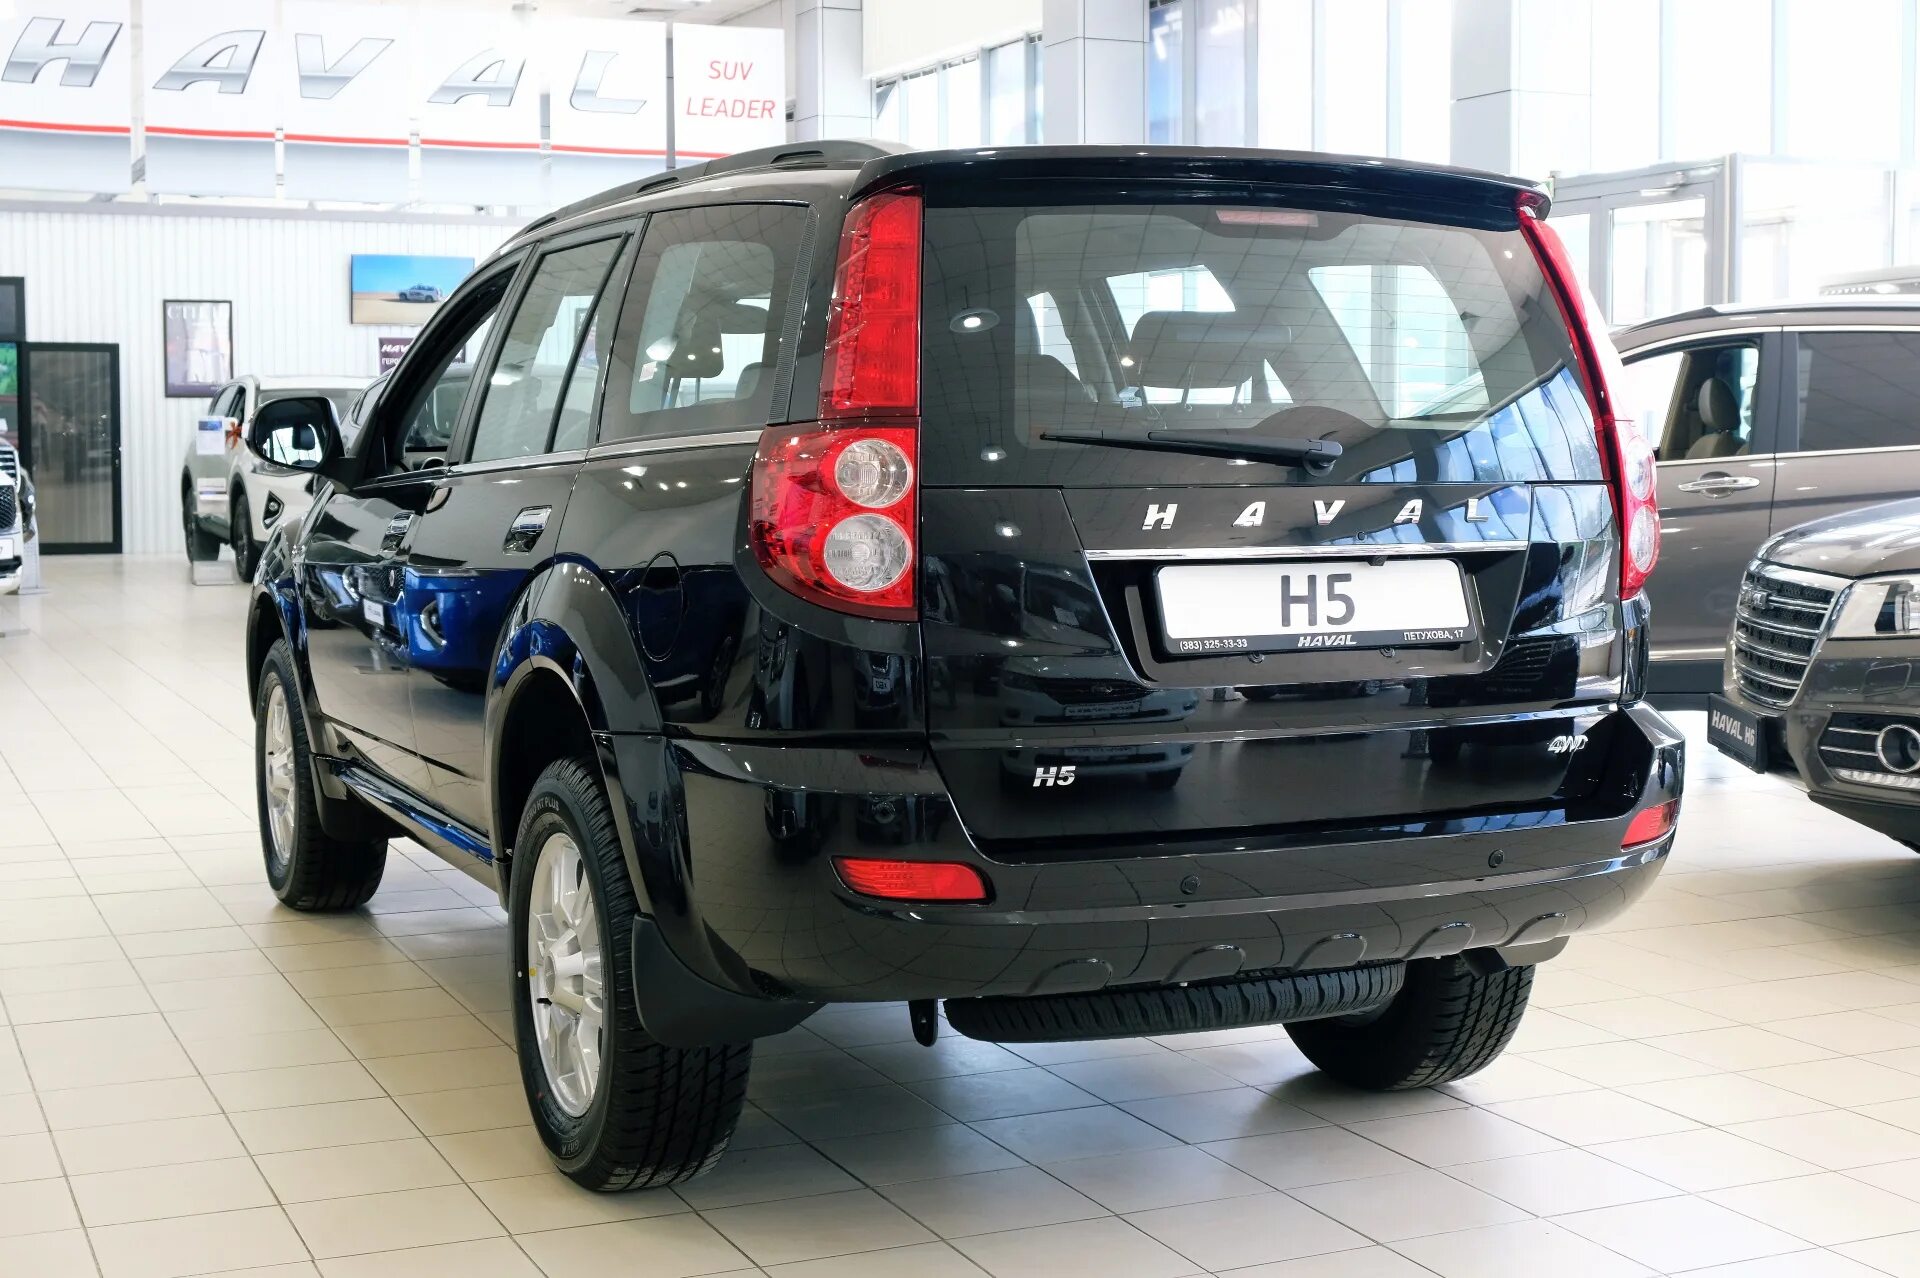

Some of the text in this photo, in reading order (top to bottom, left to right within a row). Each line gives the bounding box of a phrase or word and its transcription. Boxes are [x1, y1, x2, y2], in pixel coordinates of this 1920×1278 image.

[1, 16, 647, 114] HAVAL
[708, 60, 753, 80] SUV
[686, 97, 776, 119] LEADER
[1142, 499, 1489, 530] HAVAL
[1281, 573, 1355, 627] H5
[1180, 639, 1248, 651] (383) 325-33-33
[1298, 634, 1357, 647] HAVAL
[1403, 630, 1464, 641] ПЕТУХОВА, 17
[1711, 710, 1755, 746] HAVAL H6
[1547, 735, 1588, 753] 4WD
[1033, 765, 1076, 787] H5
